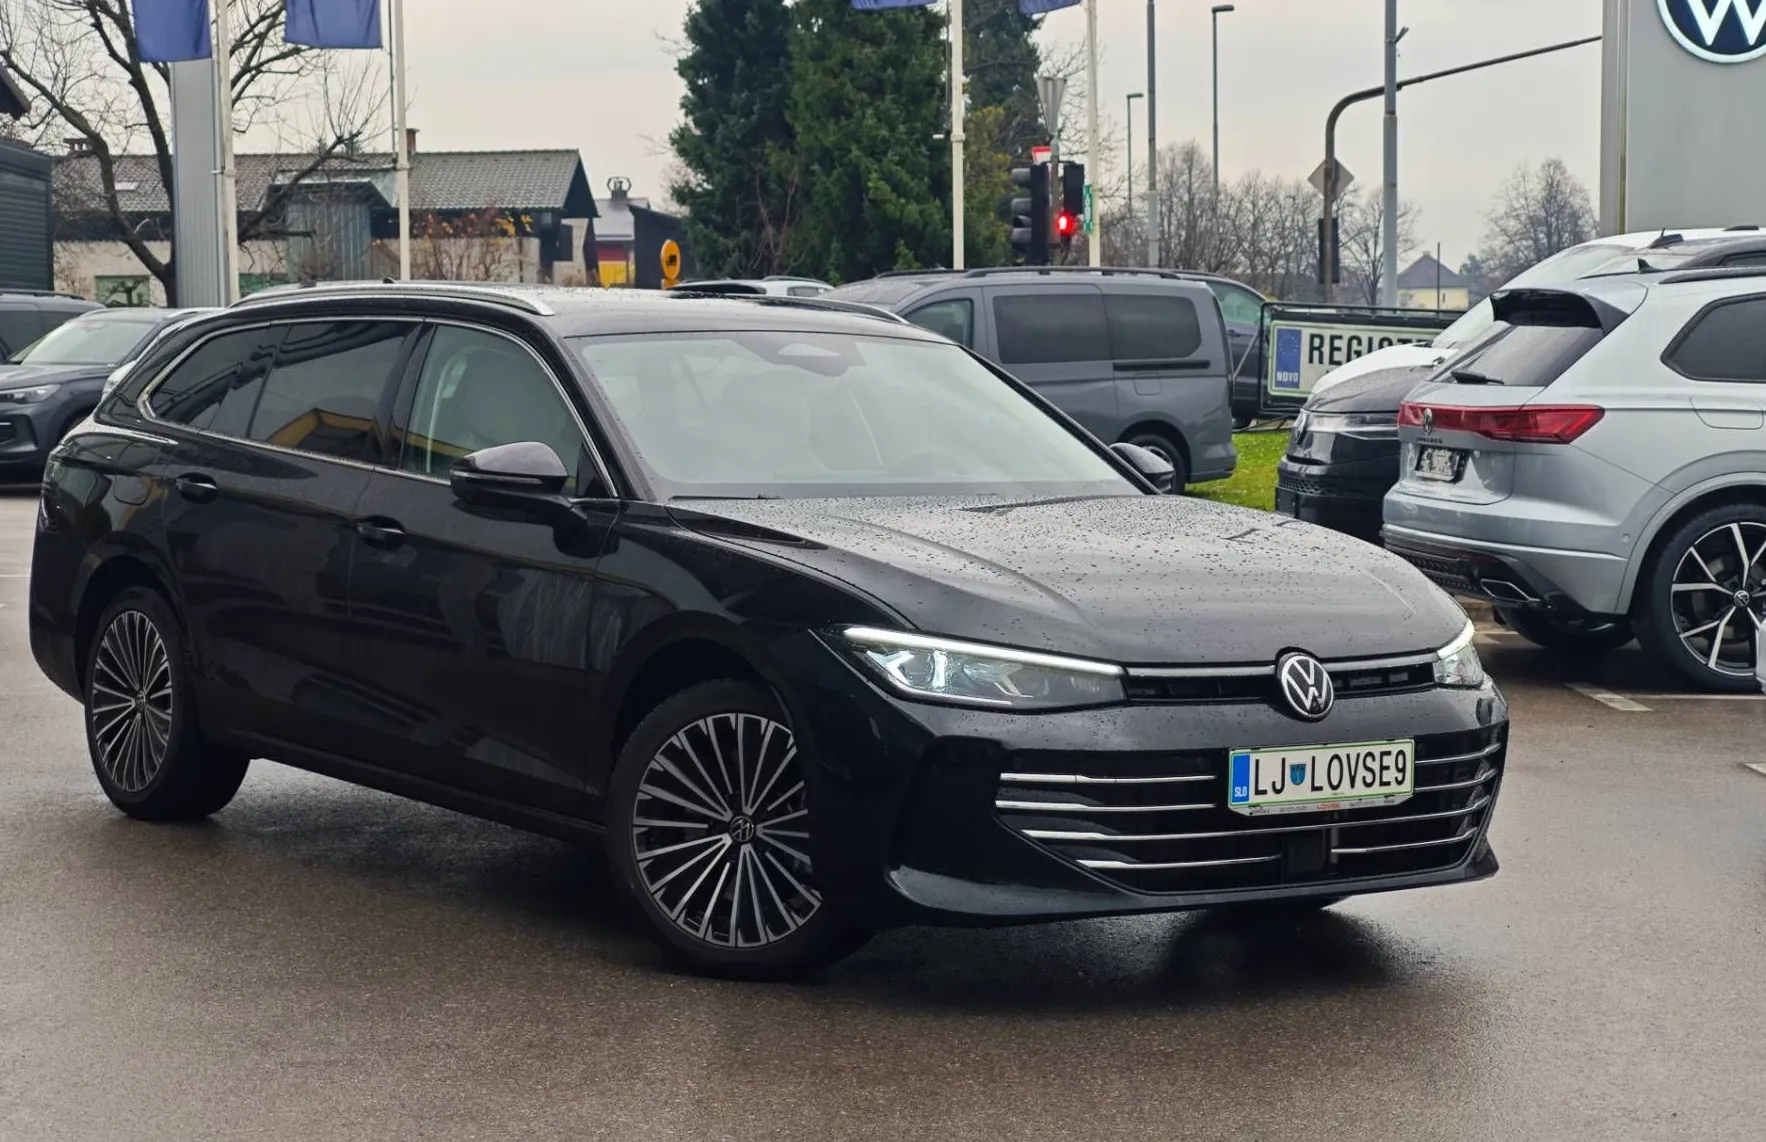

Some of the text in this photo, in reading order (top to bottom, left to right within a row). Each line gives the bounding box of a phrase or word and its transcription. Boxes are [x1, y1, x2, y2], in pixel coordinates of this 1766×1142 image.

[1276, 371, 1299, 382] NOVO
[1254, 749, 1407, 796] LJ LOVSE9
[1234, 786, 1248, 798] SLO
